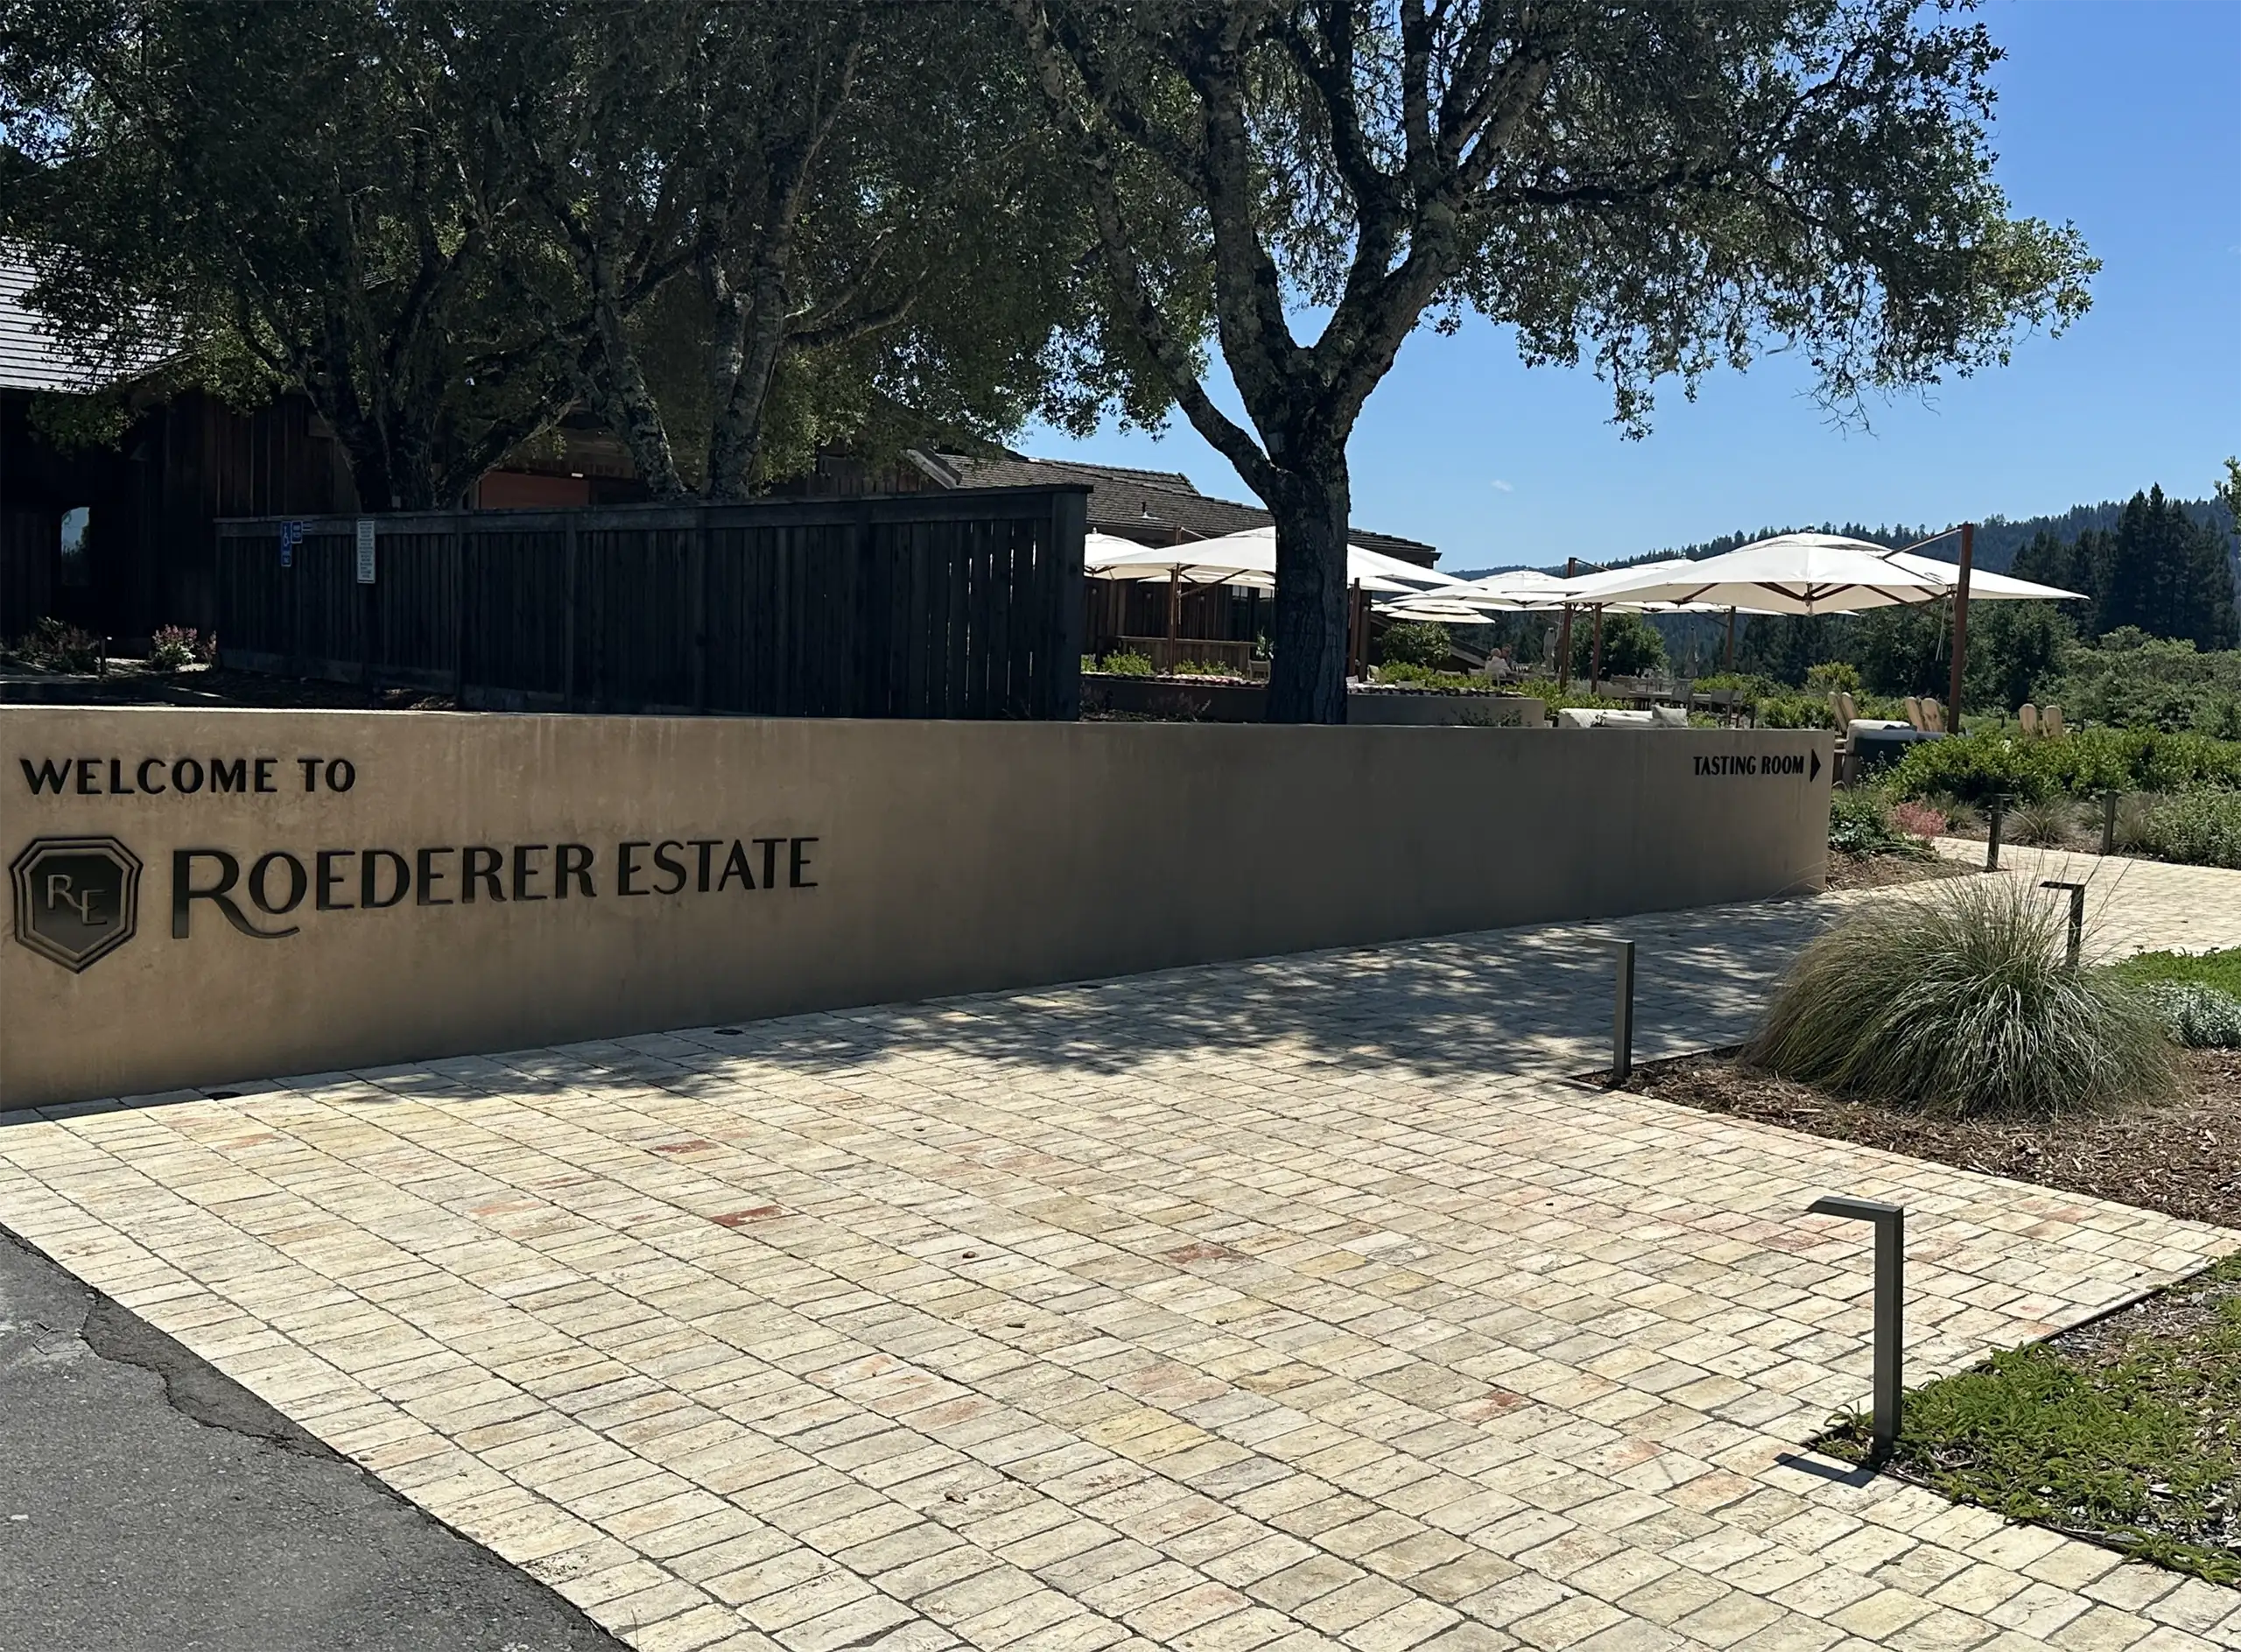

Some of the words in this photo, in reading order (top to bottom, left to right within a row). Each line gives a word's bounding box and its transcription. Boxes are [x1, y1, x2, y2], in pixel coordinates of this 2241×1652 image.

[19, 758, 278, 794] WELCOME
[297, 758, 356, 792] TO
[1693, 756, 1756, 776] TASTING
[1761, 756, 1804, 775] ROOM
[172, 843, 597, 939] ROEDERER
[617, 837, 819, 896] ESTATE
